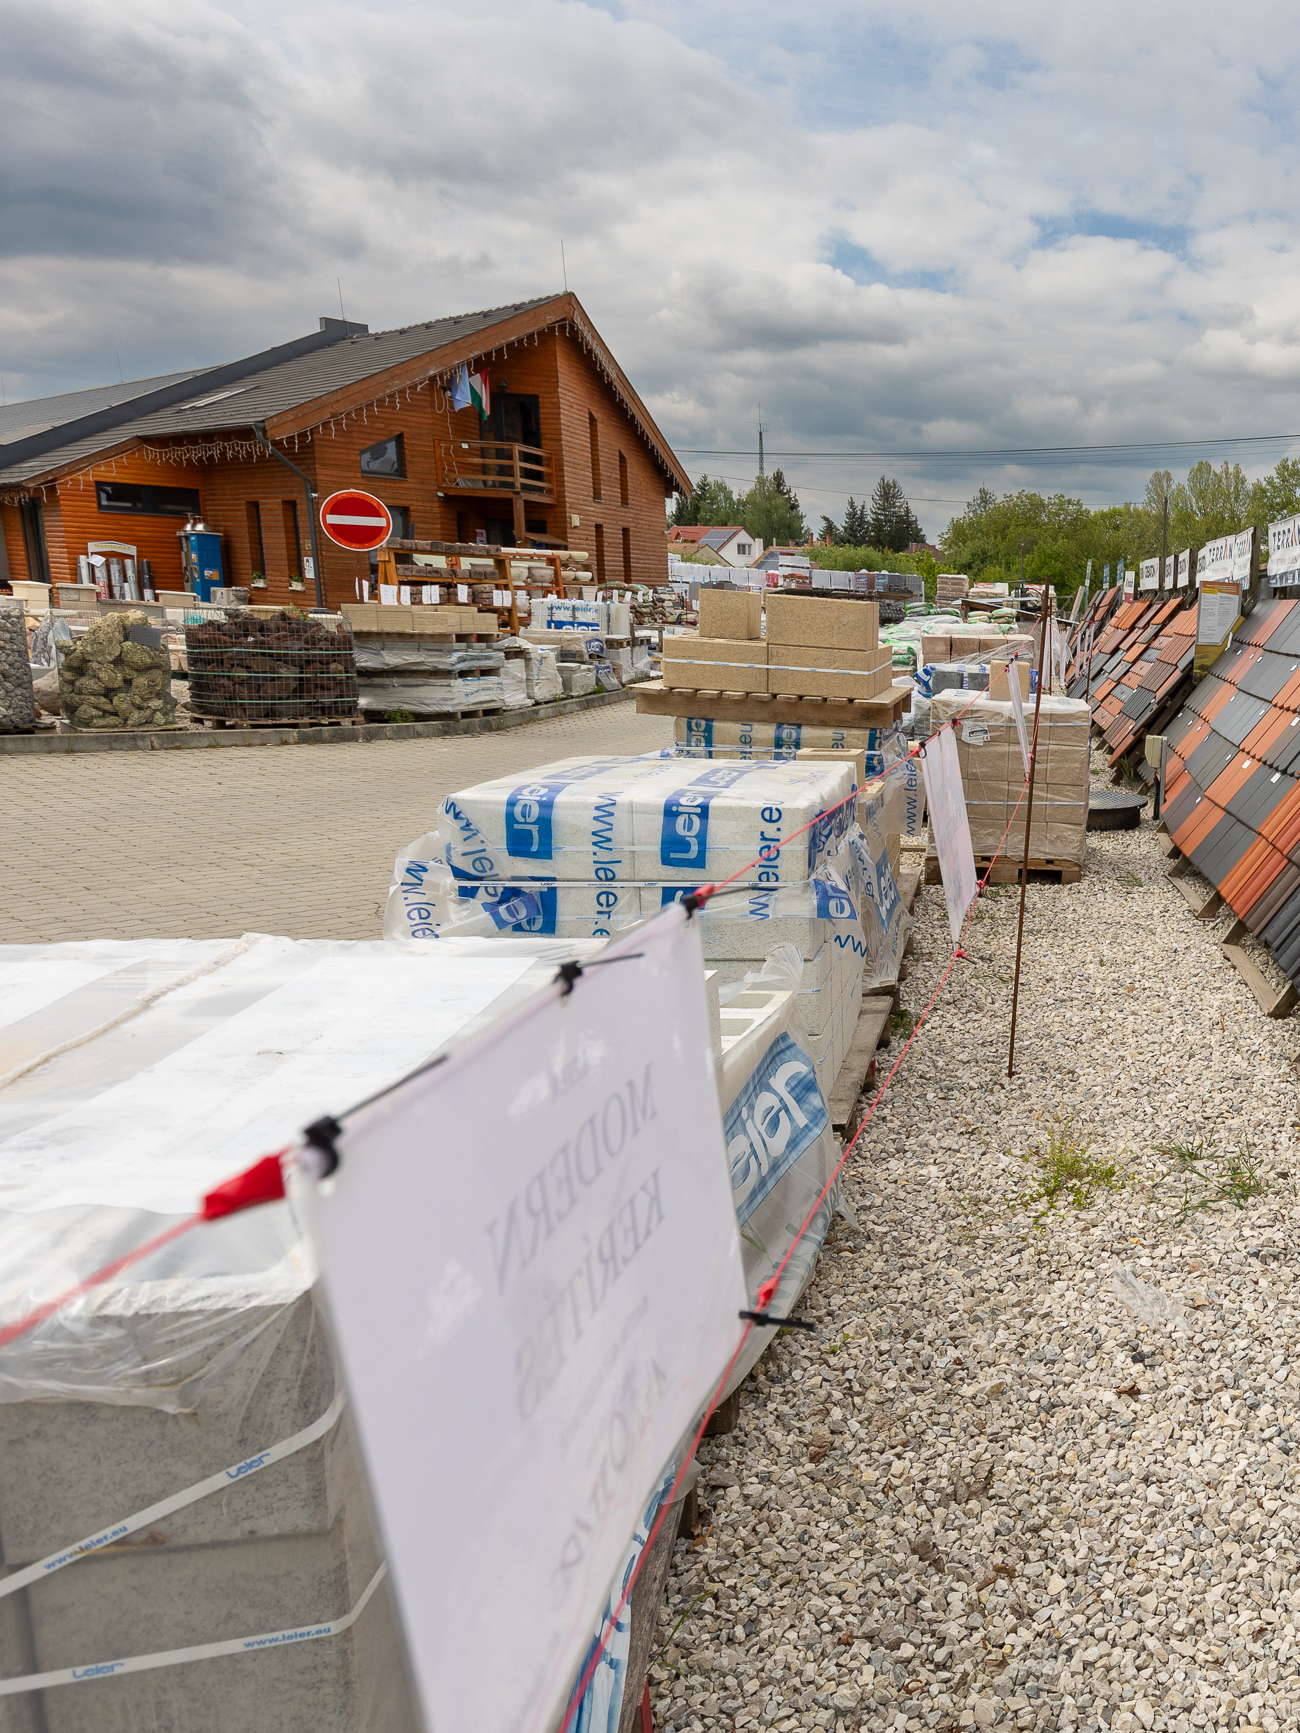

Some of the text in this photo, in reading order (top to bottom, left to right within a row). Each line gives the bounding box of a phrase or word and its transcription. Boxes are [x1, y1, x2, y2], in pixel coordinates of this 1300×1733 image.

[94, 543, 131, 551] MASTERMAX
[669, 789, 705, 860] Leier
[226, 1452, 270, 1479] Leier
[243, 1626, 331, 1649] www.leier.eu
[72, 1661, 125, 1679] Leier
